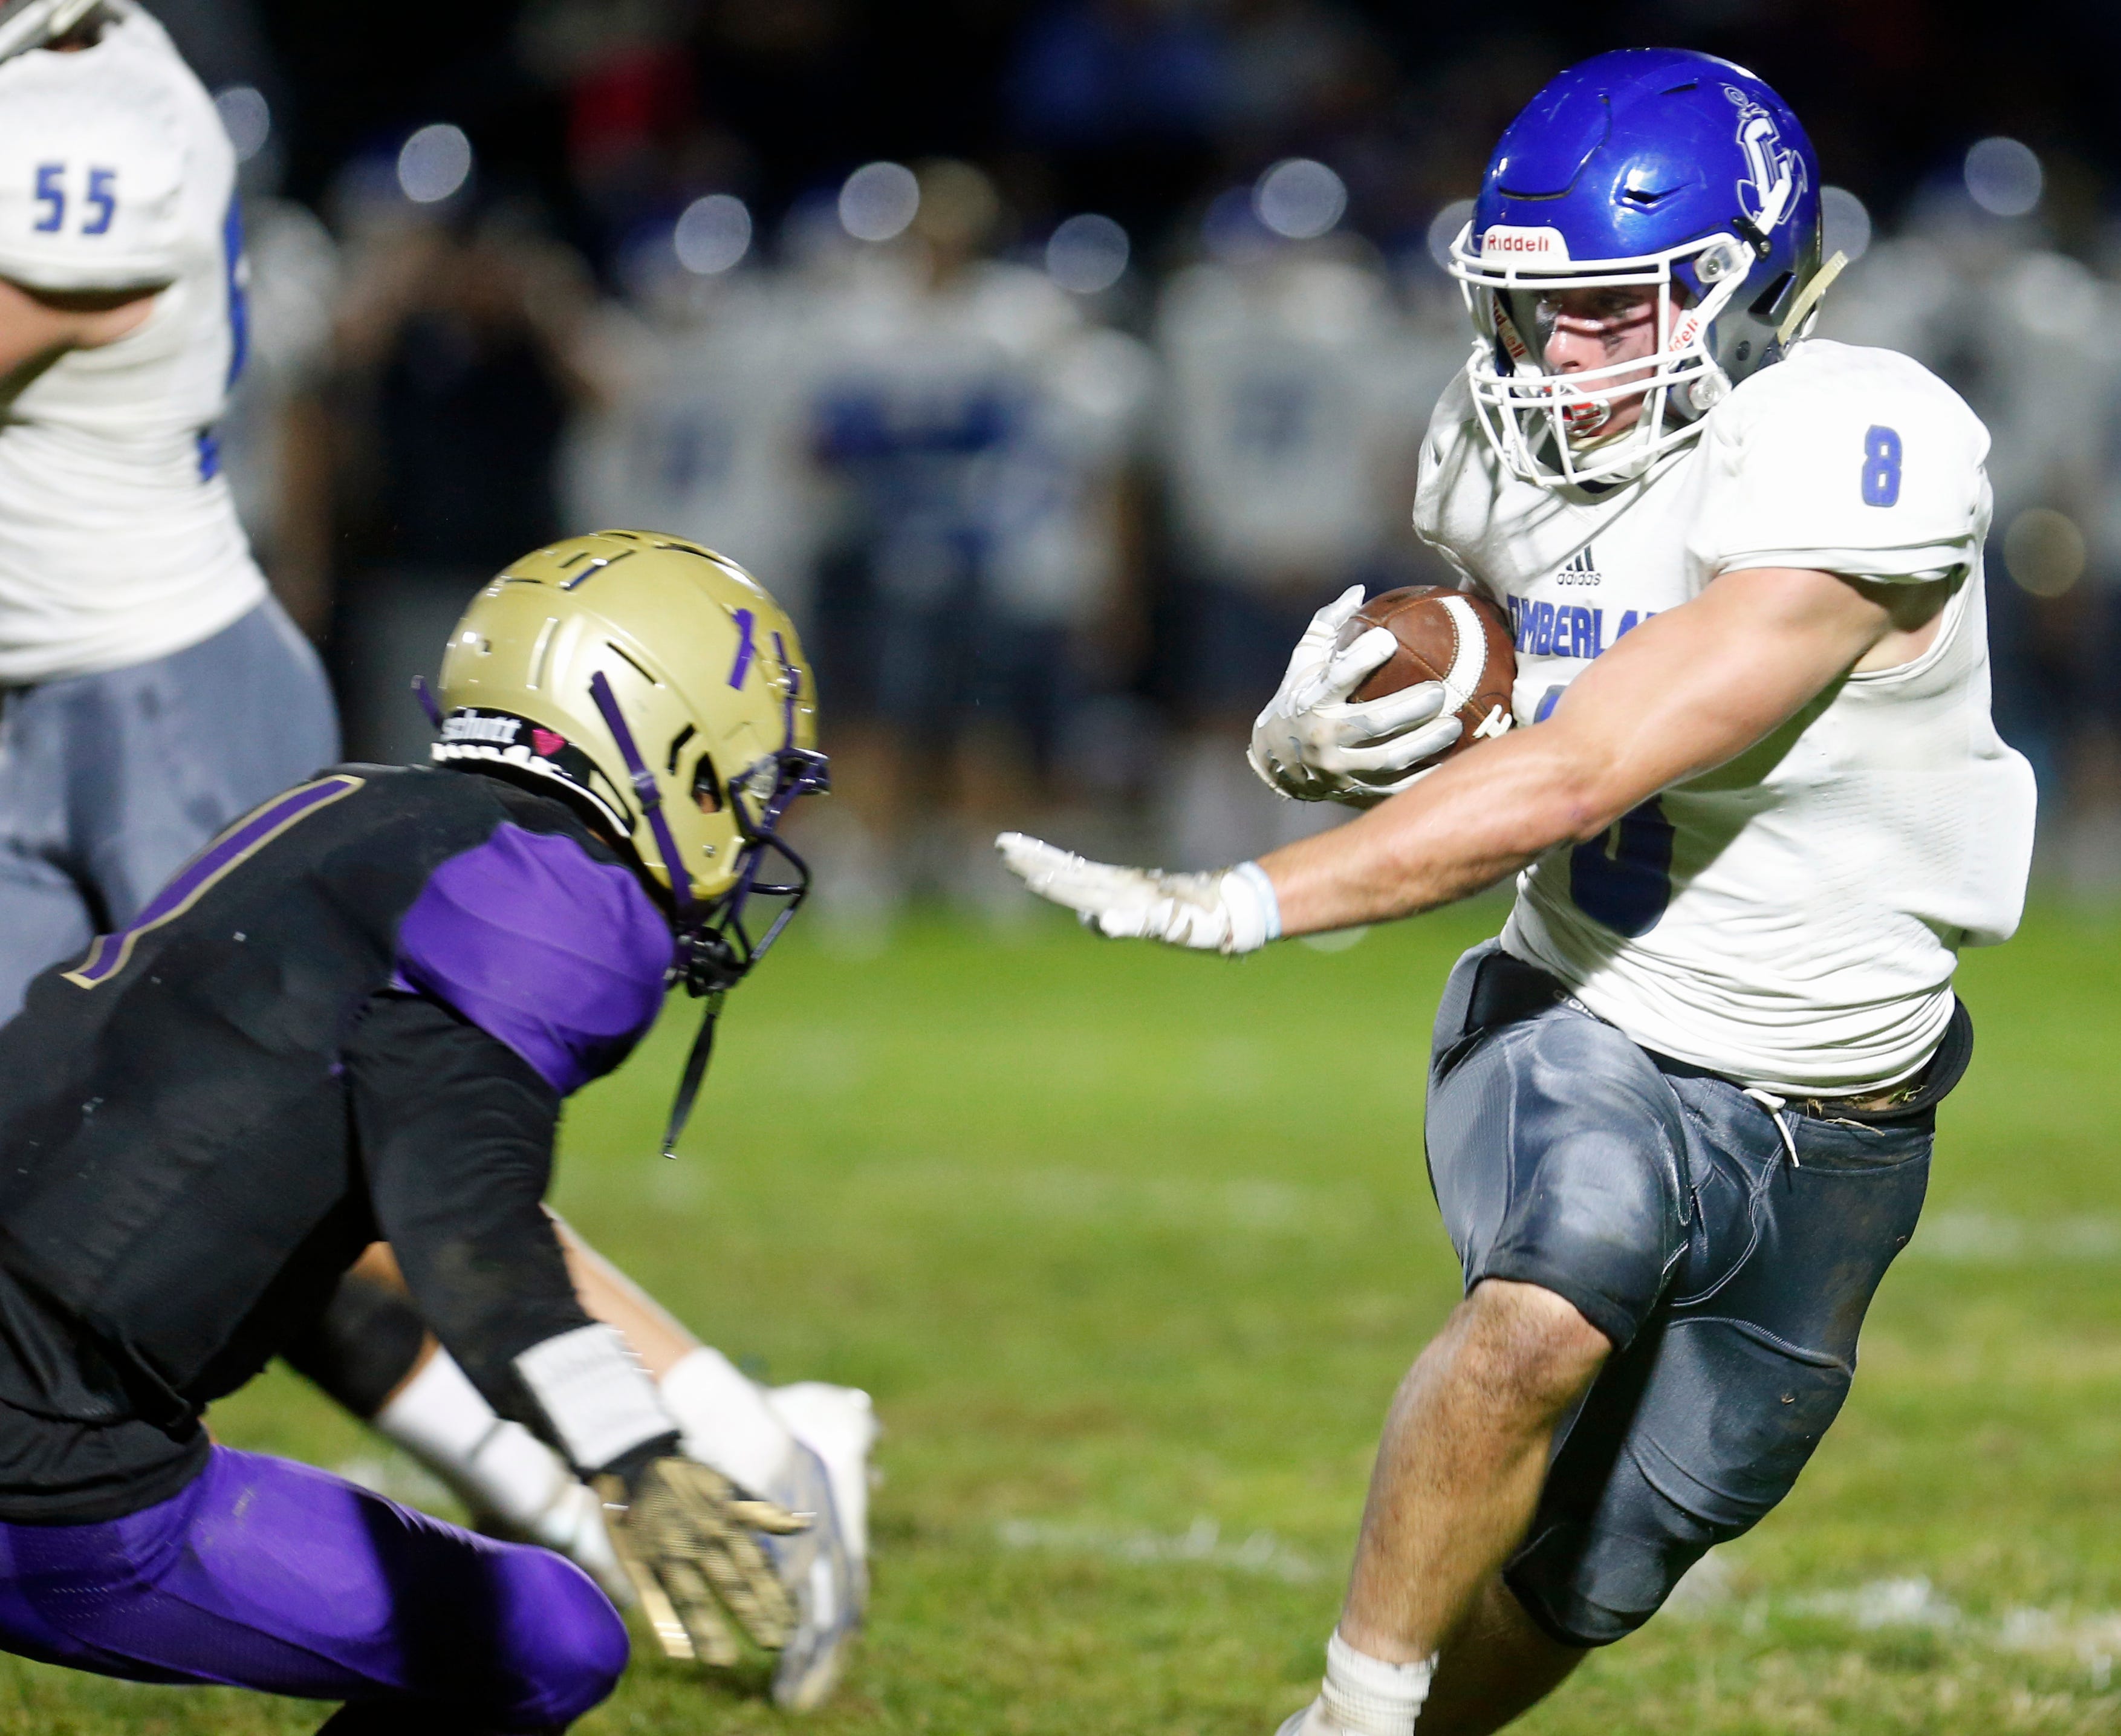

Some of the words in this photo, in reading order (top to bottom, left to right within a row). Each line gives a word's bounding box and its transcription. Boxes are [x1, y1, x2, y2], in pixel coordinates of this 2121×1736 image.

[34, 163, 117, 235] 55
[1487, 234, 1550, 252] Riddell
[1861, 424, 1903, 508] 8
[1556, 571, 1602, 586] adidas
